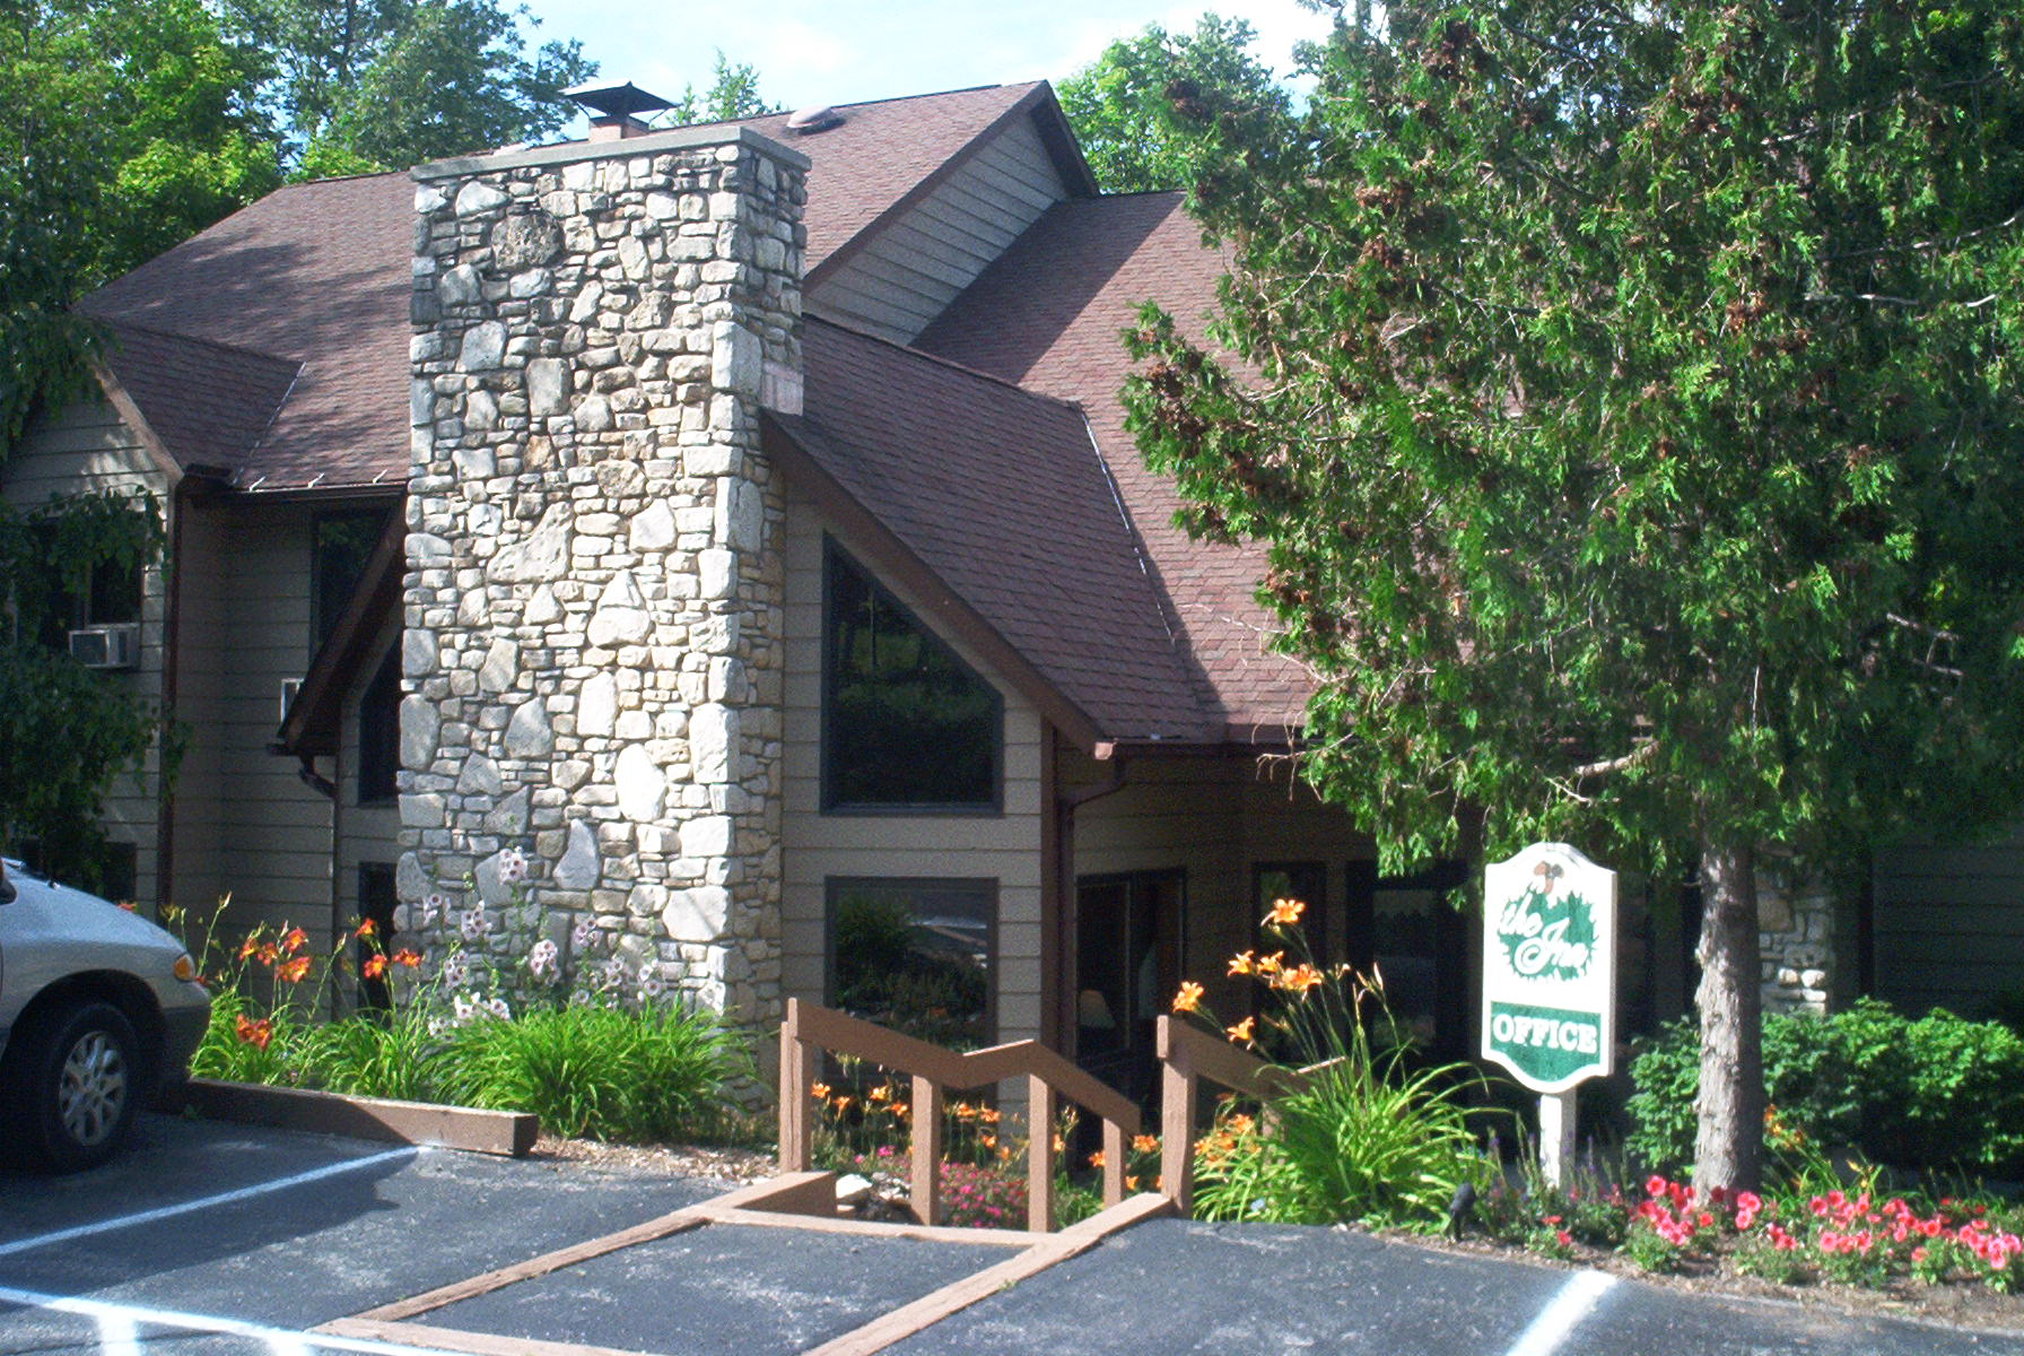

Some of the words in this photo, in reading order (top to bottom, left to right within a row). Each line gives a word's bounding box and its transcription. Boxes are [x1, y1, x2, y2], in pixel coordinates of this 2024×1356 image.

[1500, 891, 1543, 937] the
[1514, 917, 1588, 975] Inn
[1493, 1013, 1597, 1054] OFFICE
